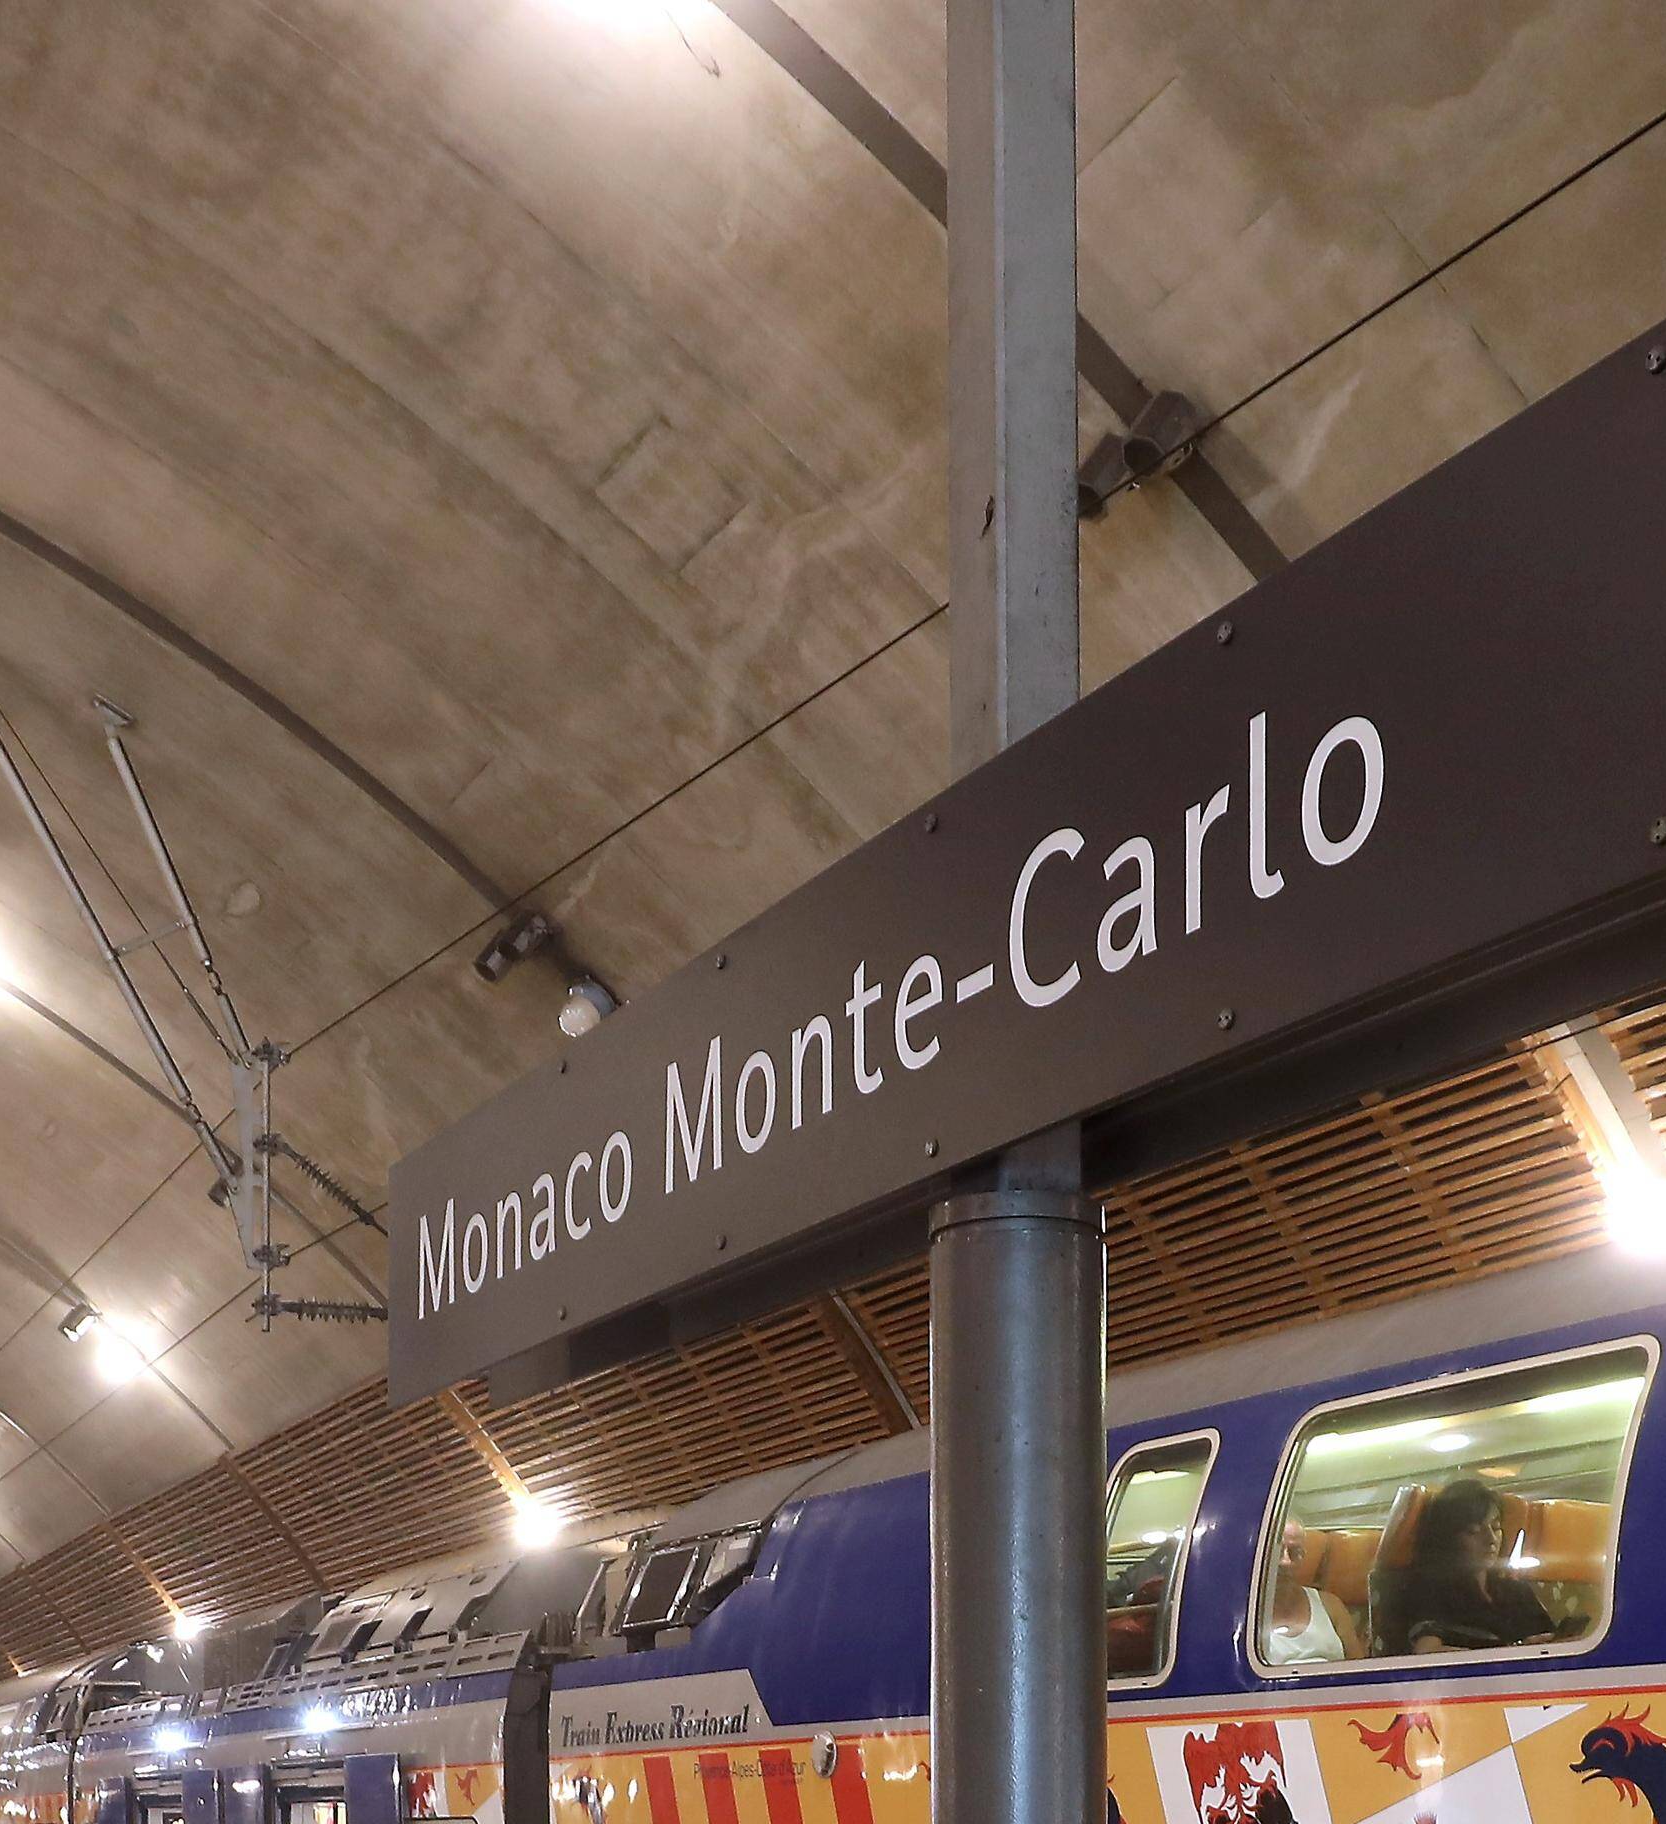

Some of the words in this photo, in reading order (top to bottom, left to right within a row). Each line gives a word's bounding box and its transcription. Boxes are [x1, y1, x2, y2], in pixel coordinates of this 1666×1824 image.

[417, 1129, 635, 1322] Monaco
[663, 710, 1387, 1195] Monte-Carlo
[560, 1714, 600, 1748] Train
[604, 1710, 665, 1744] Express
[669, 1703, 750, 1740] Régional
